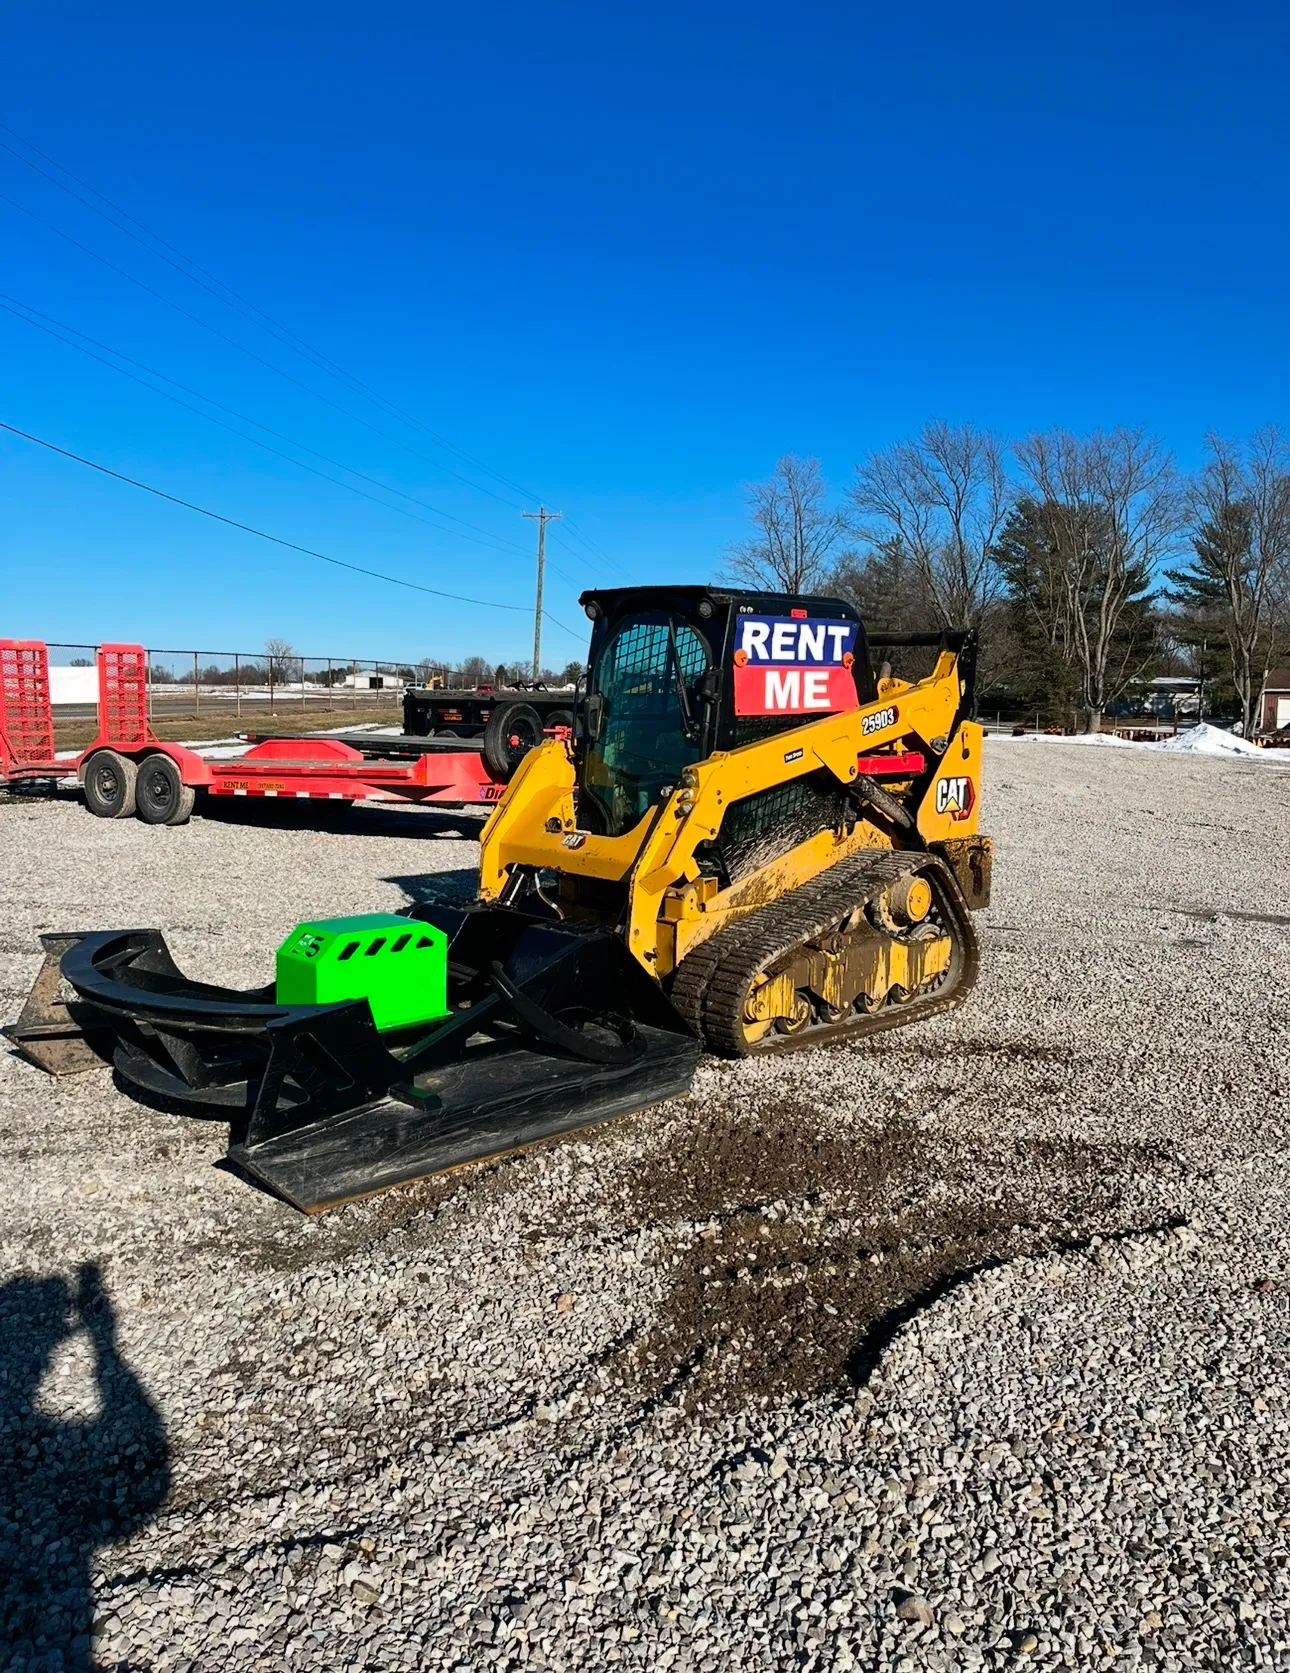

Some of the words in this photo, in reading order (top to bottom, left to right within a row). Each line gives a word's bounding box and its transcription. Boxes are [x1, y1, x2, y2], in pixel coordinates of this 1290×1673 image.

[743, 621, 850, 661] RENT
[764, 670, 832, 709] ME
[861, 708, 895, 736] 259D3
[223, 781, 239, 789] RENT
[240, 781, 249, 789] ME
[937, 777, 968, 814] CAT
[561, 833, 584, 847] CAT
